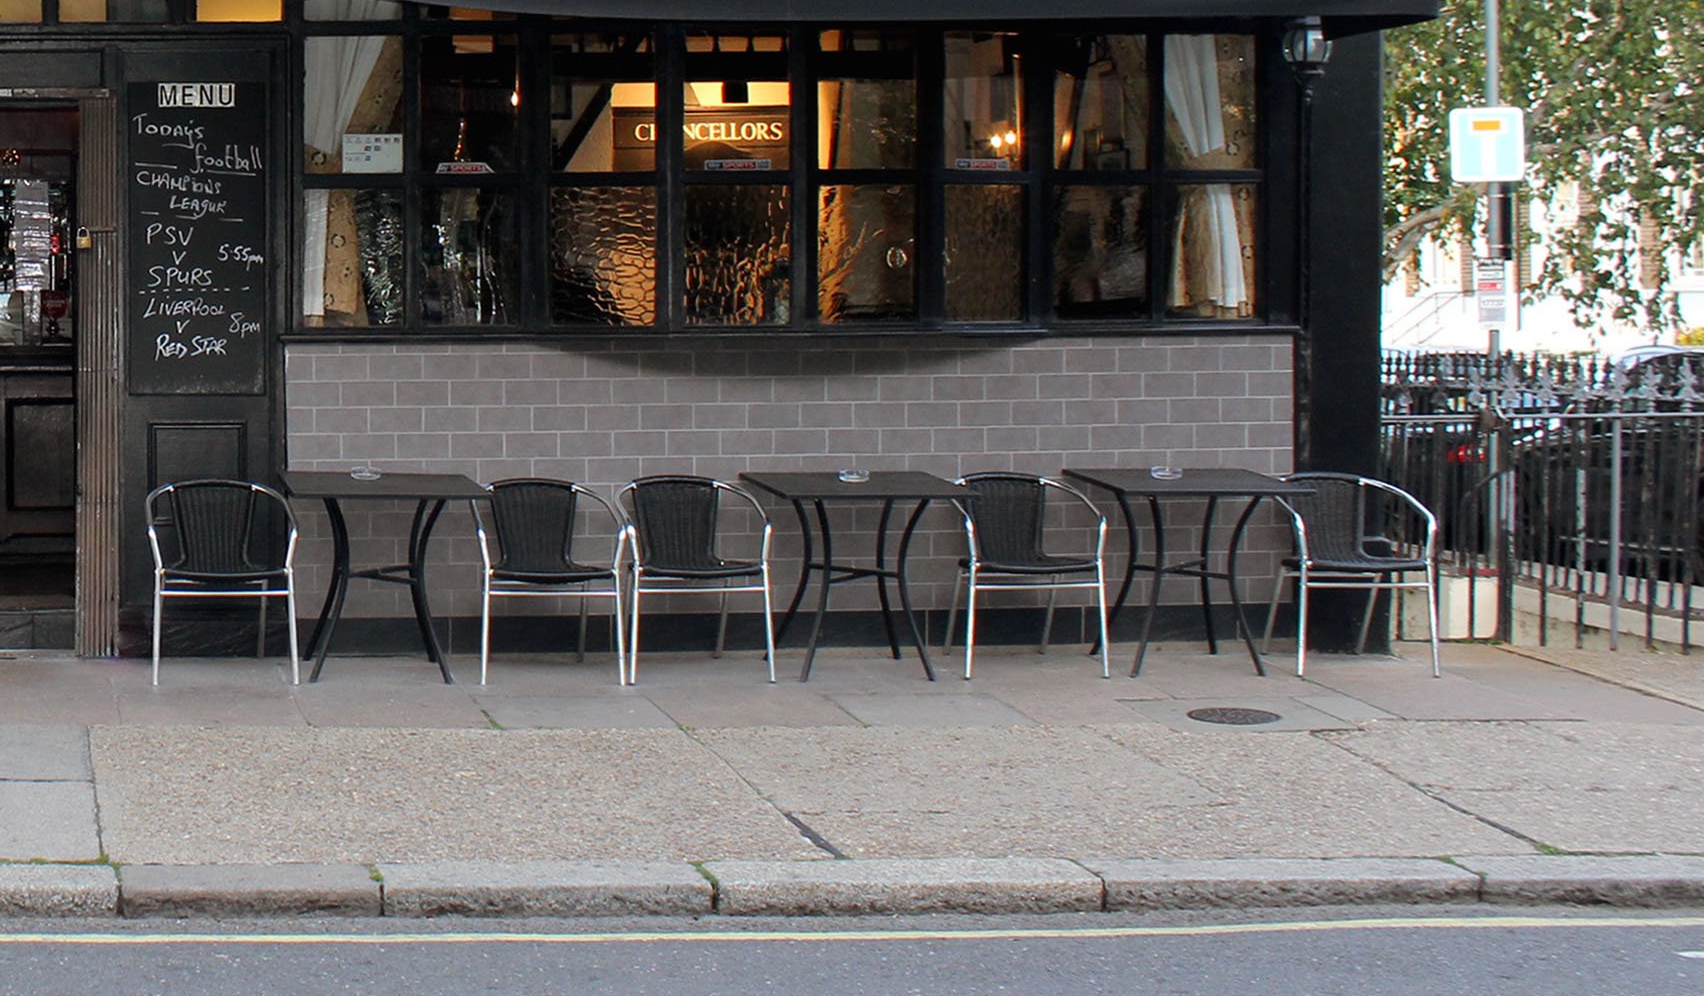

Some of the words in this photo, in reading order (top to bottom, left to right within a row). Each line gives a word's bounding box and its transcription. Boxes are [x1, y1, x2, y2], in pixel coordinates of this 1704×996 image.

[159, 84, 233, 106] MENU
[635, 122, 783, 142] CNCELLORS
[146, 222, 194, 246] PSV
[147, 265, 213, 287] SPURS
[143, 295, 225, 318] LIVERPOOL
[191, 335, 228, 357] STAR
